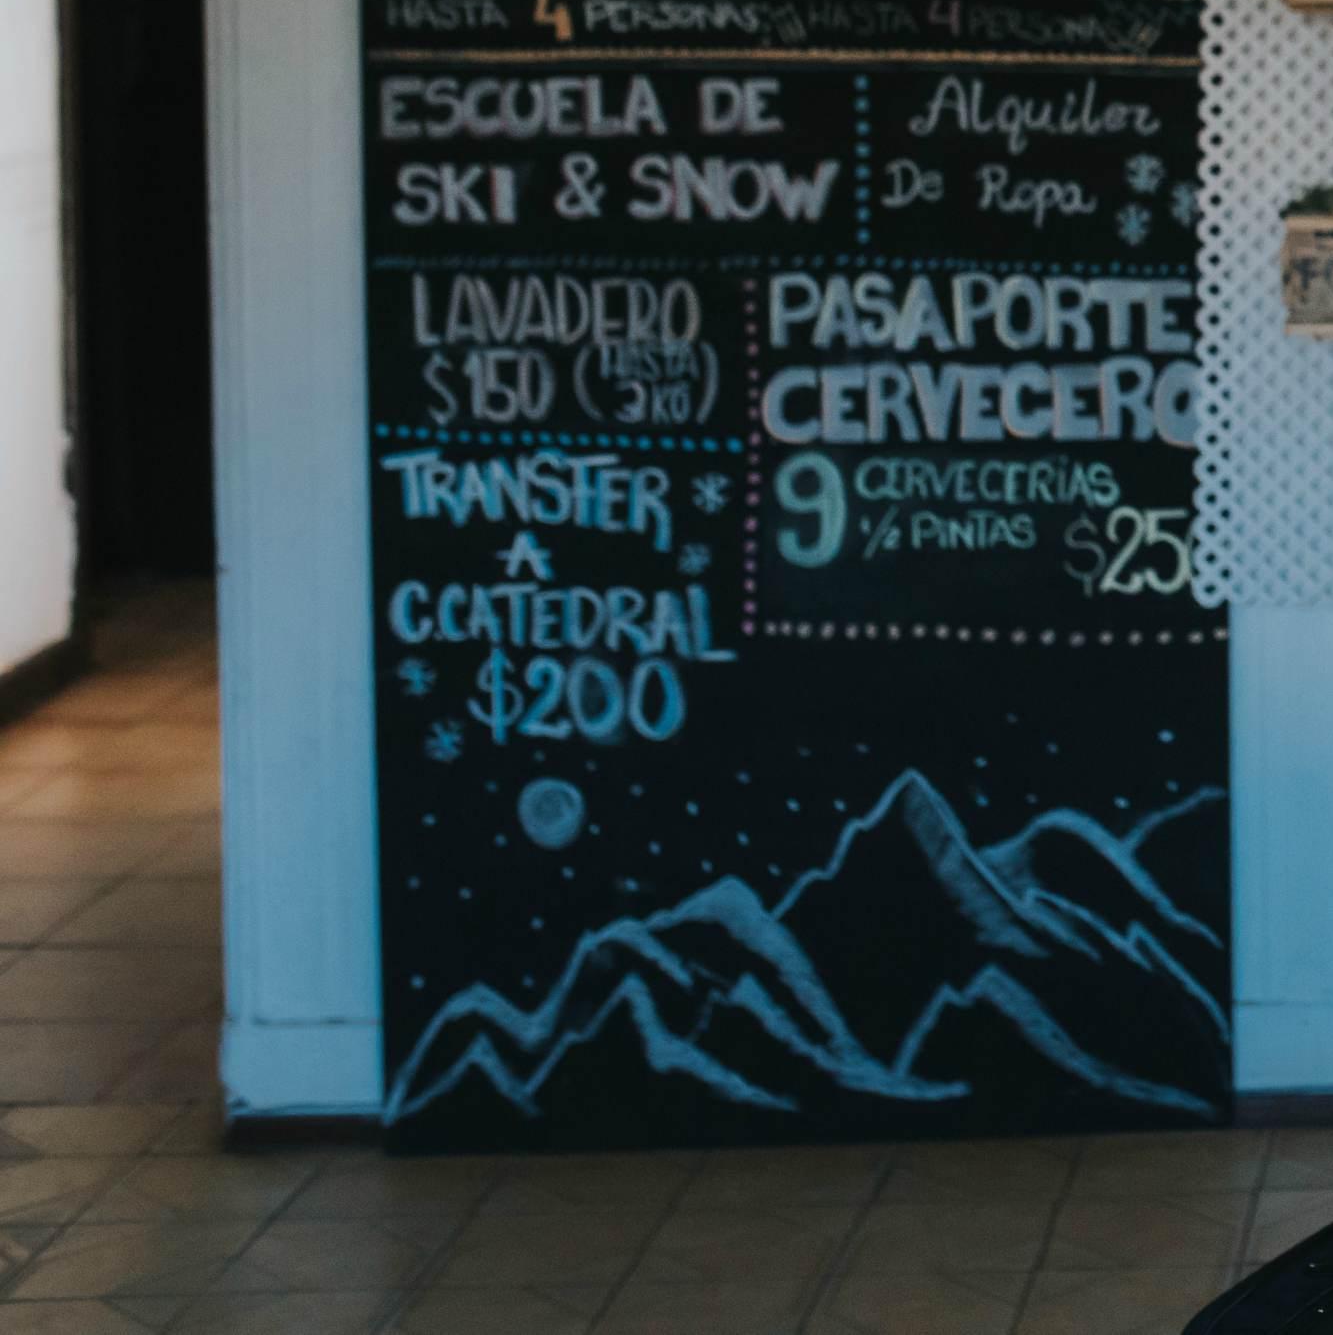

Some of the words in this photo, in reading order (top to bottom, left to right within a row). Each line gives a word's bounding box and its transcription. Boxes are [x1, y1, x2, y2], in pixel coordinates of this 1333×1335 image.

[378, 73, 668, 140] ESCUELA
[698, 76, 784, 136] DE
[908, 74, 1161, 156] Alquiler
[391, 161, 518, 226] SKI
[553, 151, 607, 219] &
[626, 152, 841, 223] SNOW
[976, 161, 1099, 230] Ropa
[411, 272, 702, 348] LAVADERO
[769, 271, 1196, 354] PASAPORTE
[421, 347, 558, 426] $150
[761, 355, 1202, 449] CERVECERO
[380, 447, 673, 553] TRANSFER
[773, 450, 848, 568] 9
[910, 508, 1037, 552] PINTAS
[497, 530, 554, 580] A
[1062, 505, 1200, 597] $25
[466, 648, 687, 745] $200
